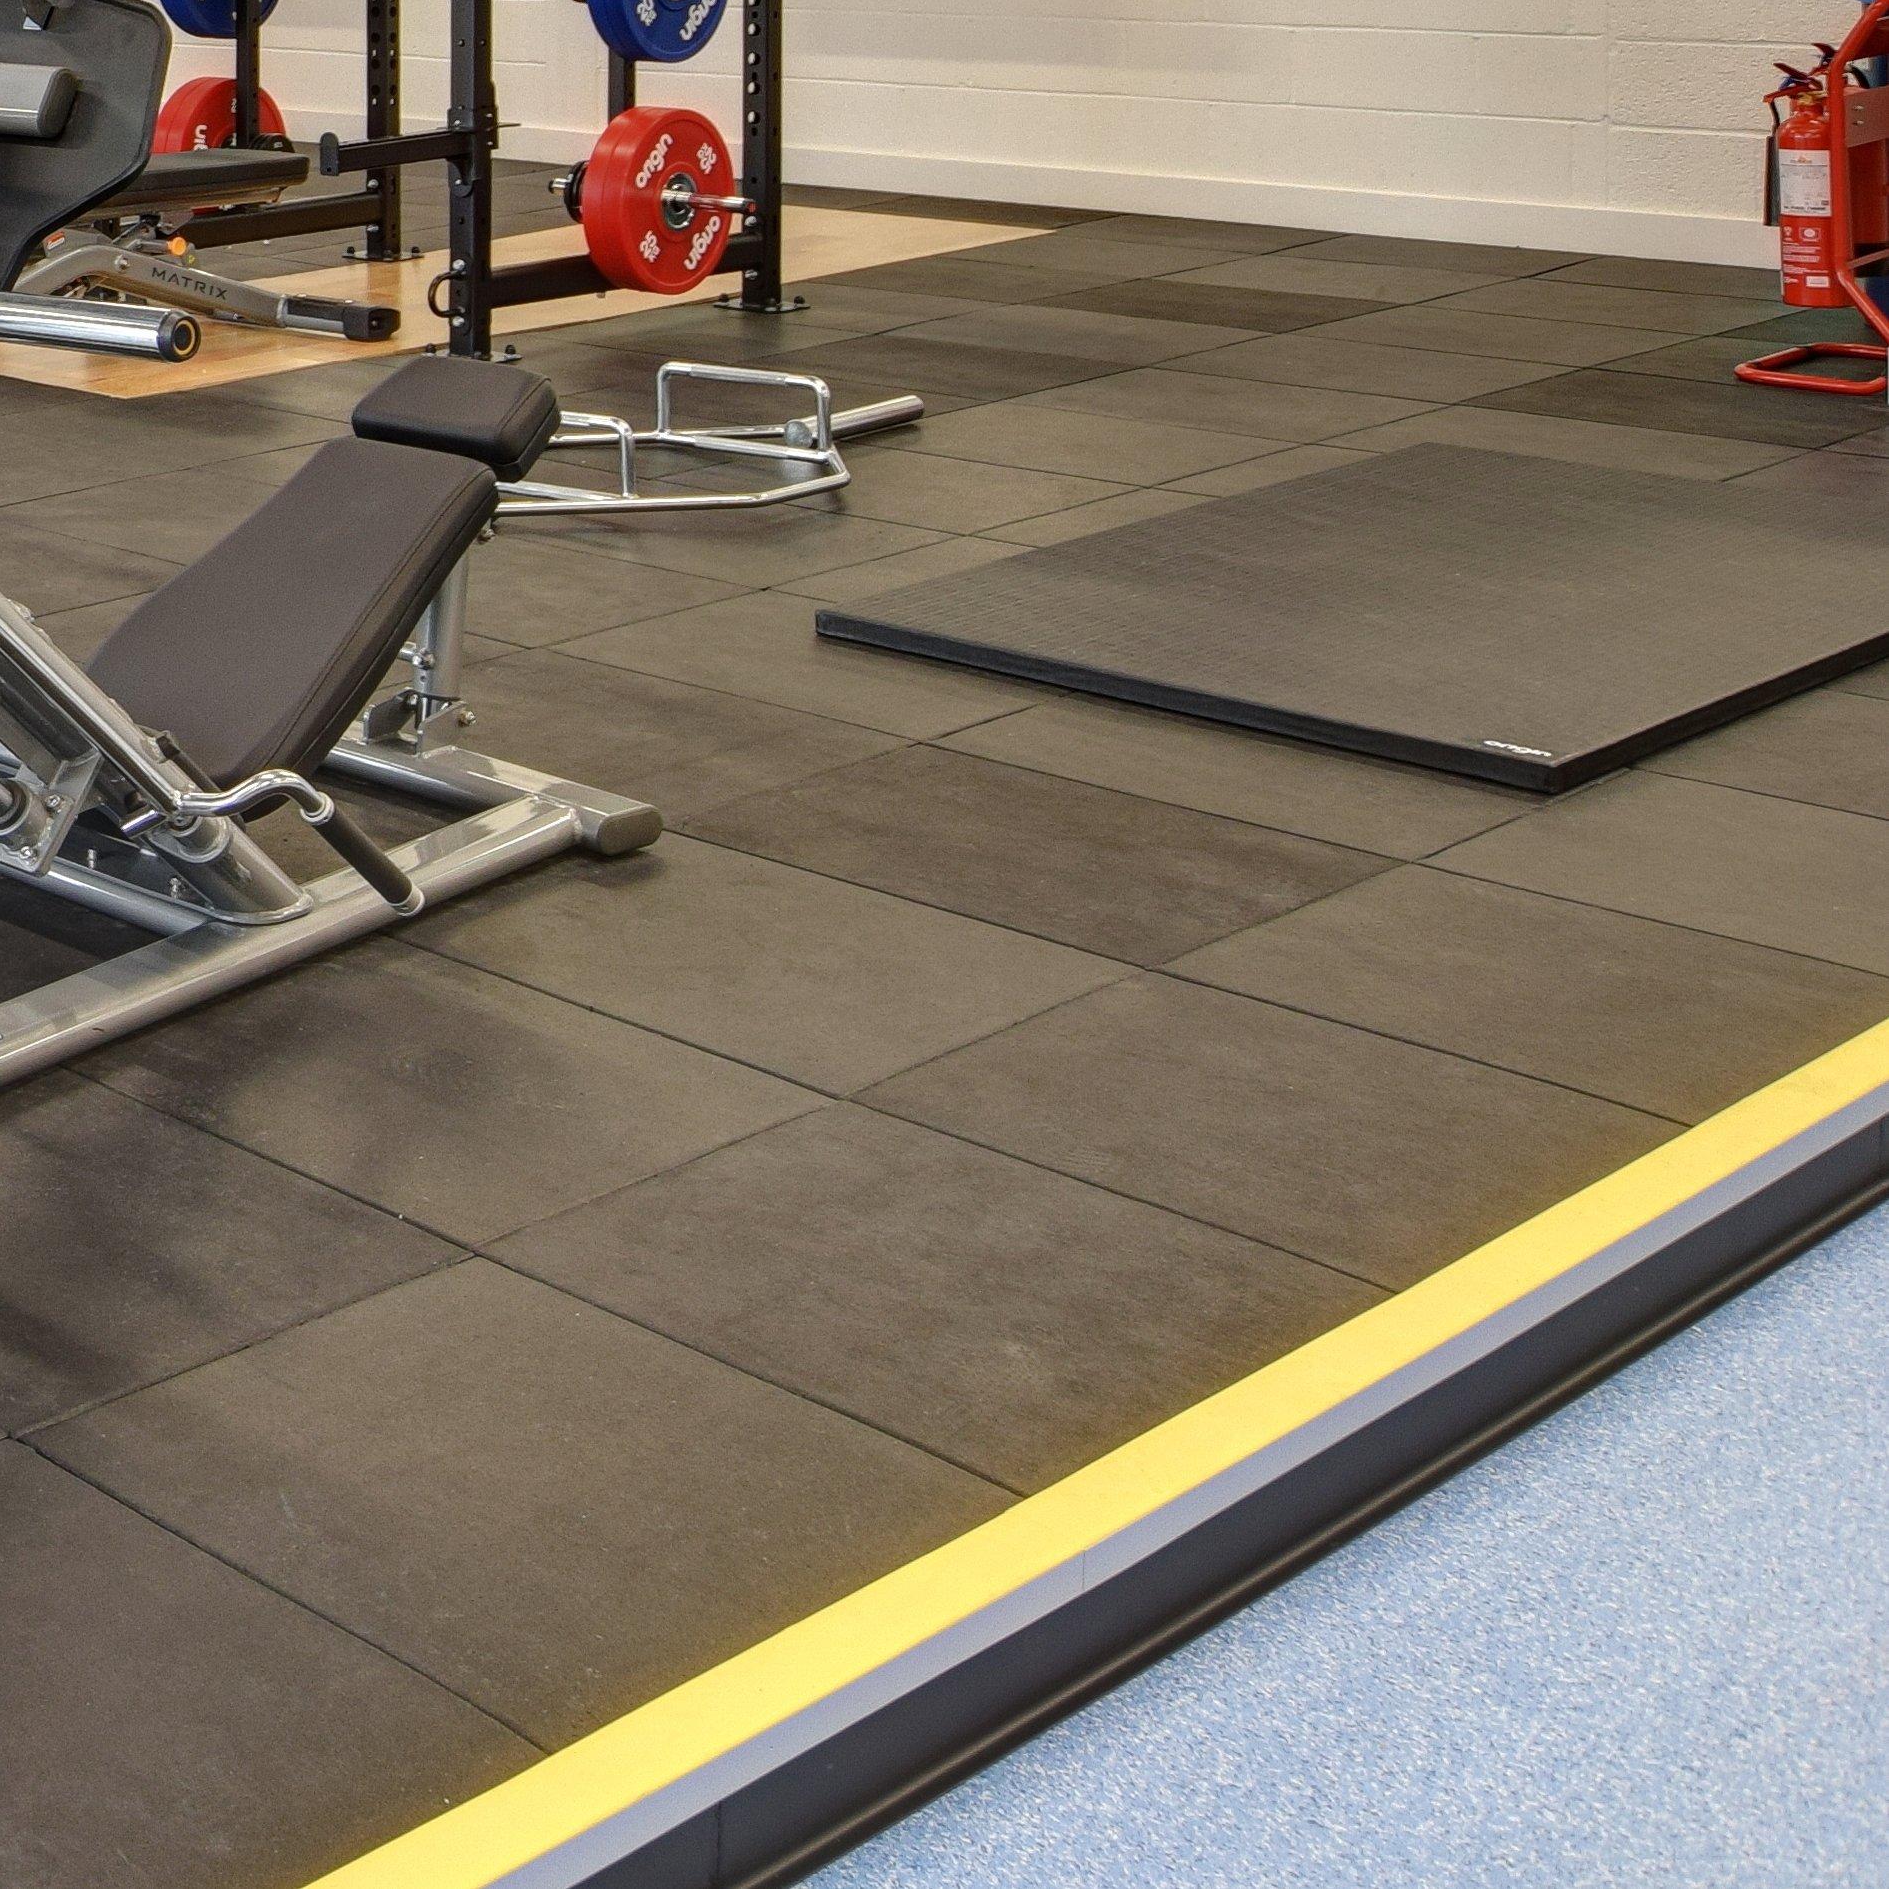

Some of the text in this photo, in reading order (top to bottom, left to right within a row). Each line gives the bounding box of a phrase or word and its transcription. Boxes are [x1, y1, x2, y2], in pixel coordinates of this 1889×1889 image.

[635, 133, 674, 189] origin
[684, 216, 721, 271] origin
[151, 267, 228, 300] MATRIX
[1483, 740, 1552, 757] origin
